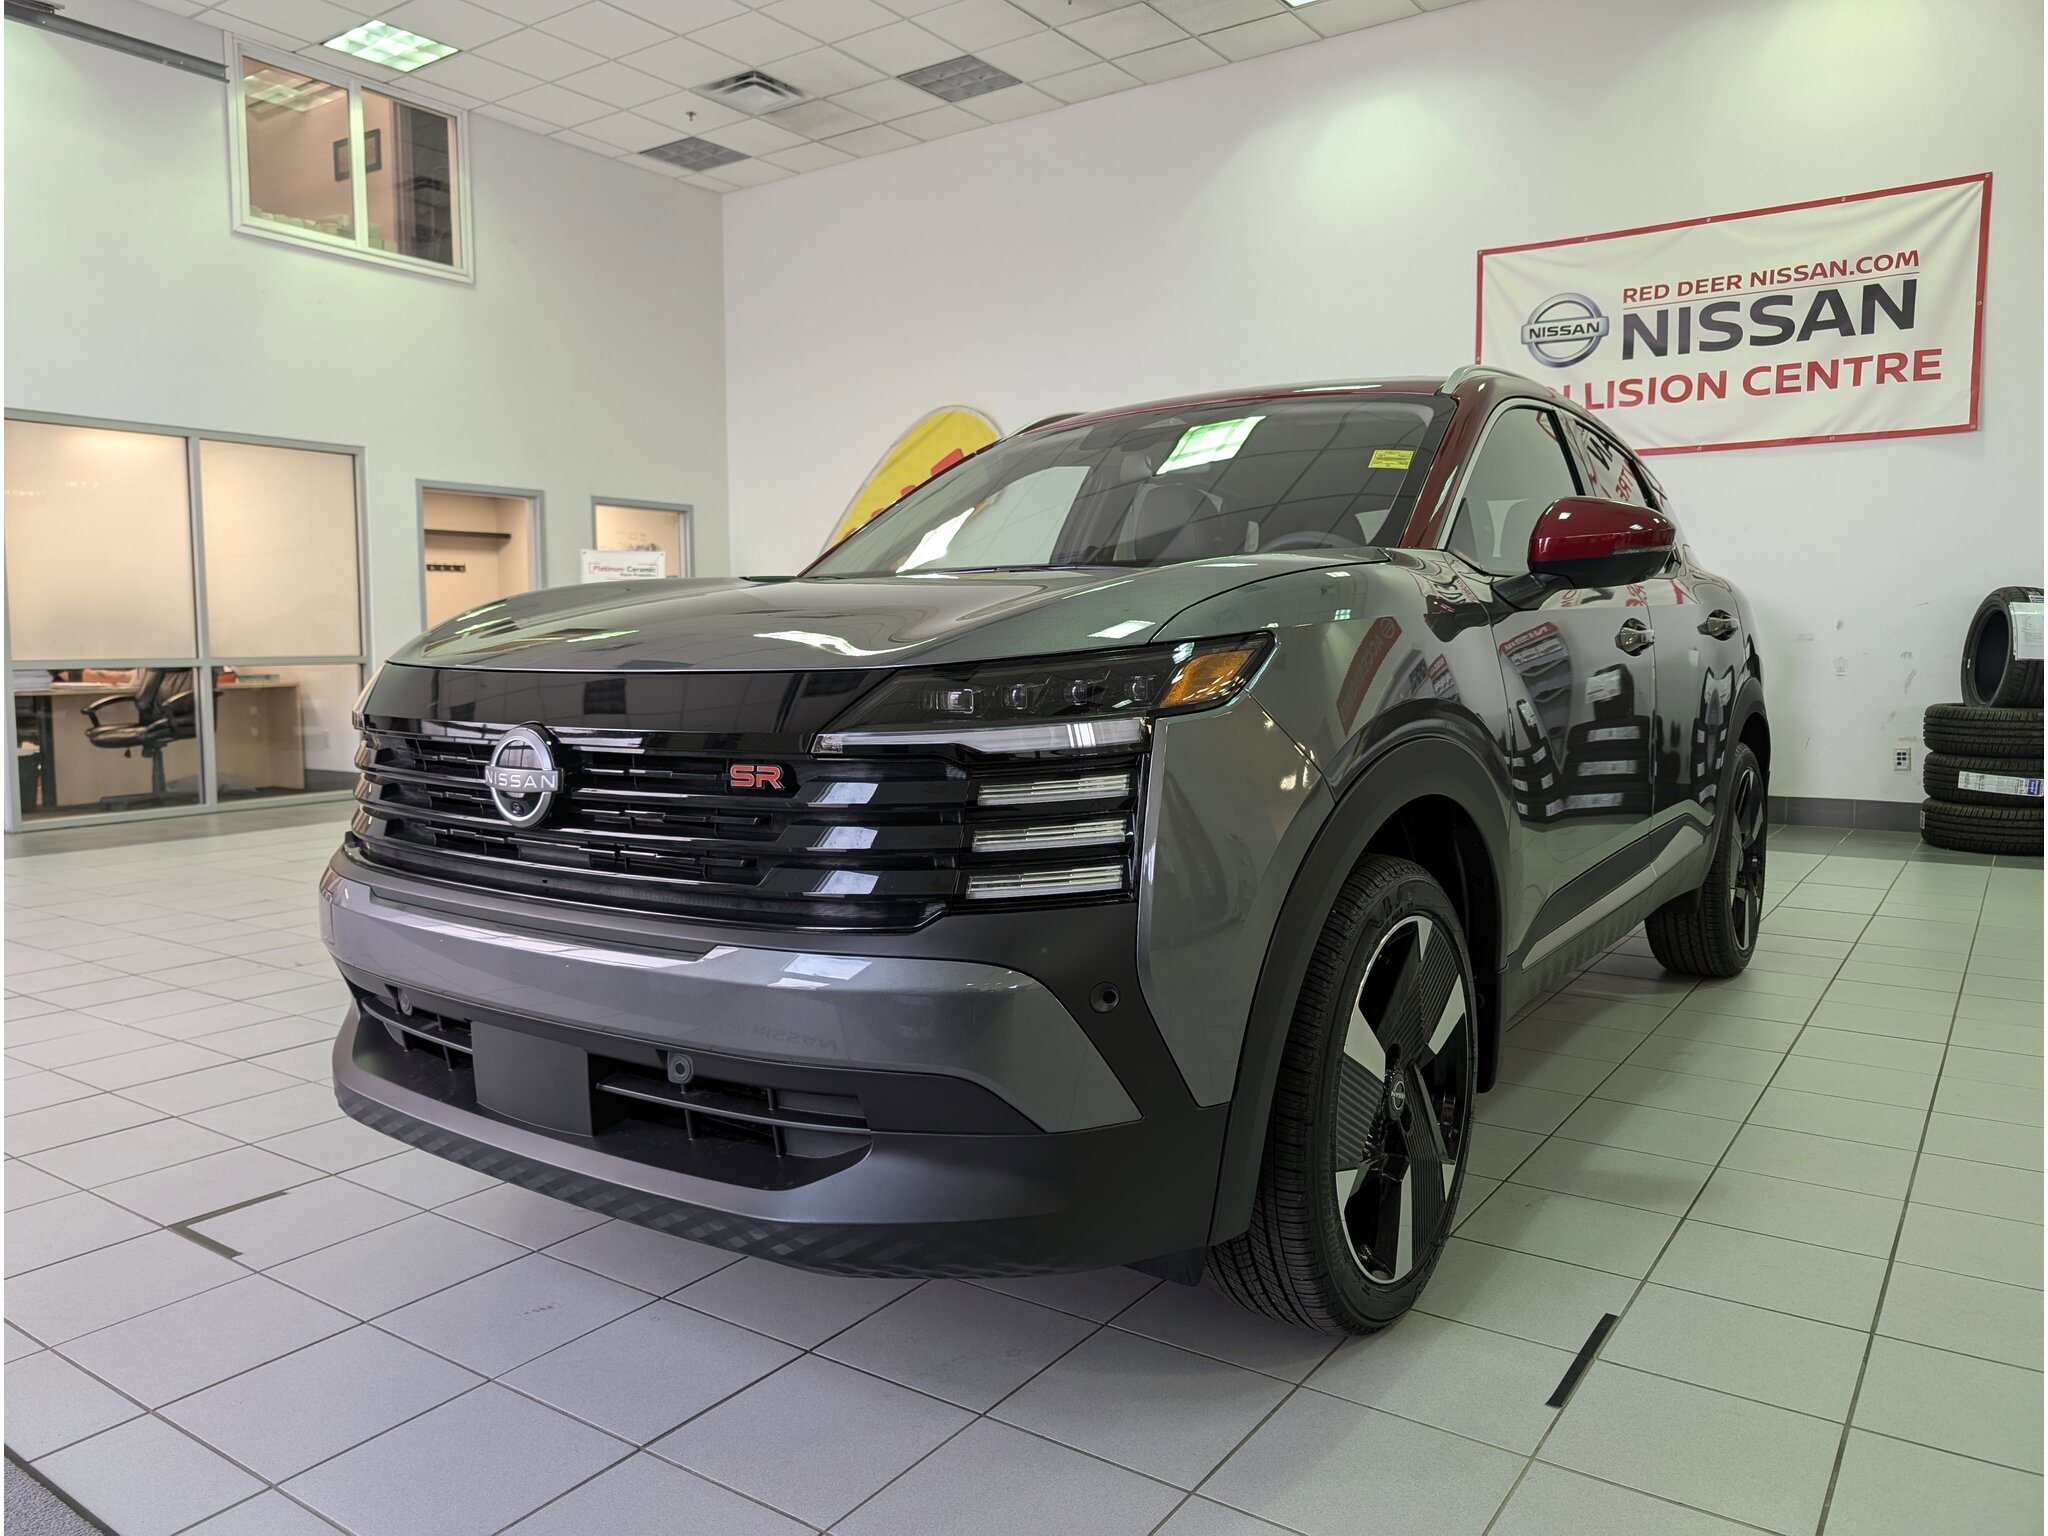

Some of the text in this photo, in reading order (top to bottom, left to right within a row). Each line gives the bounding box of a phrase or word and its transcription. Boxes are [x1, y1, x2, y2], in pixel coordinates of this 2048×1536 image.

[1622, 250, 1920, 304] RED DEER NISSAN.COM
[1529, 321, 1601, 339] NISSAN
[1622, 279, 1918, 361] NISSAN
[1548, 348, 1943, 410] LISION CENTRE
[485, 771, 557, 789] NISSAN
[730, 764, 784, 790] SR
